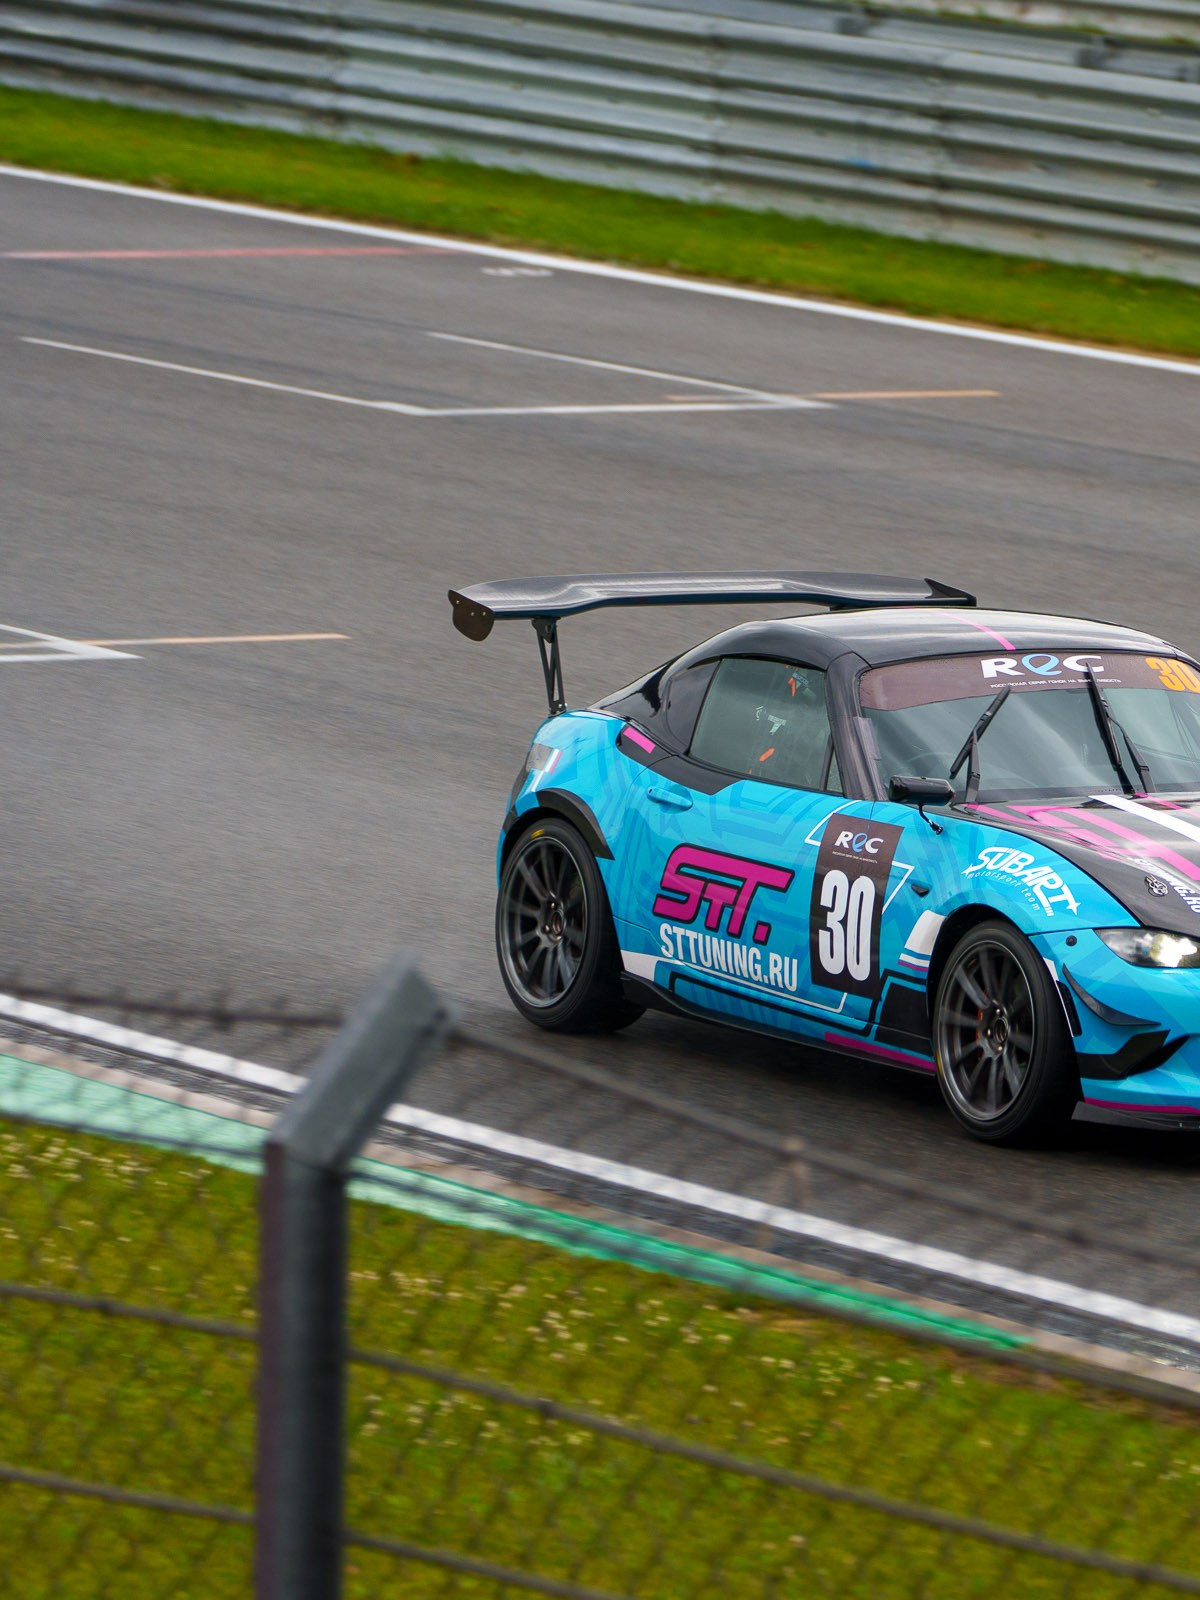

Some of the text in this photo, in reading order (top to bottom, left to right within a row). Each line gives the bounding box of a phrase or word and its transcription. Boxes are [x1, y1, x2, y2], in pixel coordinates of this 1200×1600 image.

[962, 846, 1081, 917] SUBART
[966, 869, 1041, 911] motorsport team
[659, 922, 798, 992] STTUNING.RU
[818, 869, 876, 982] 30
